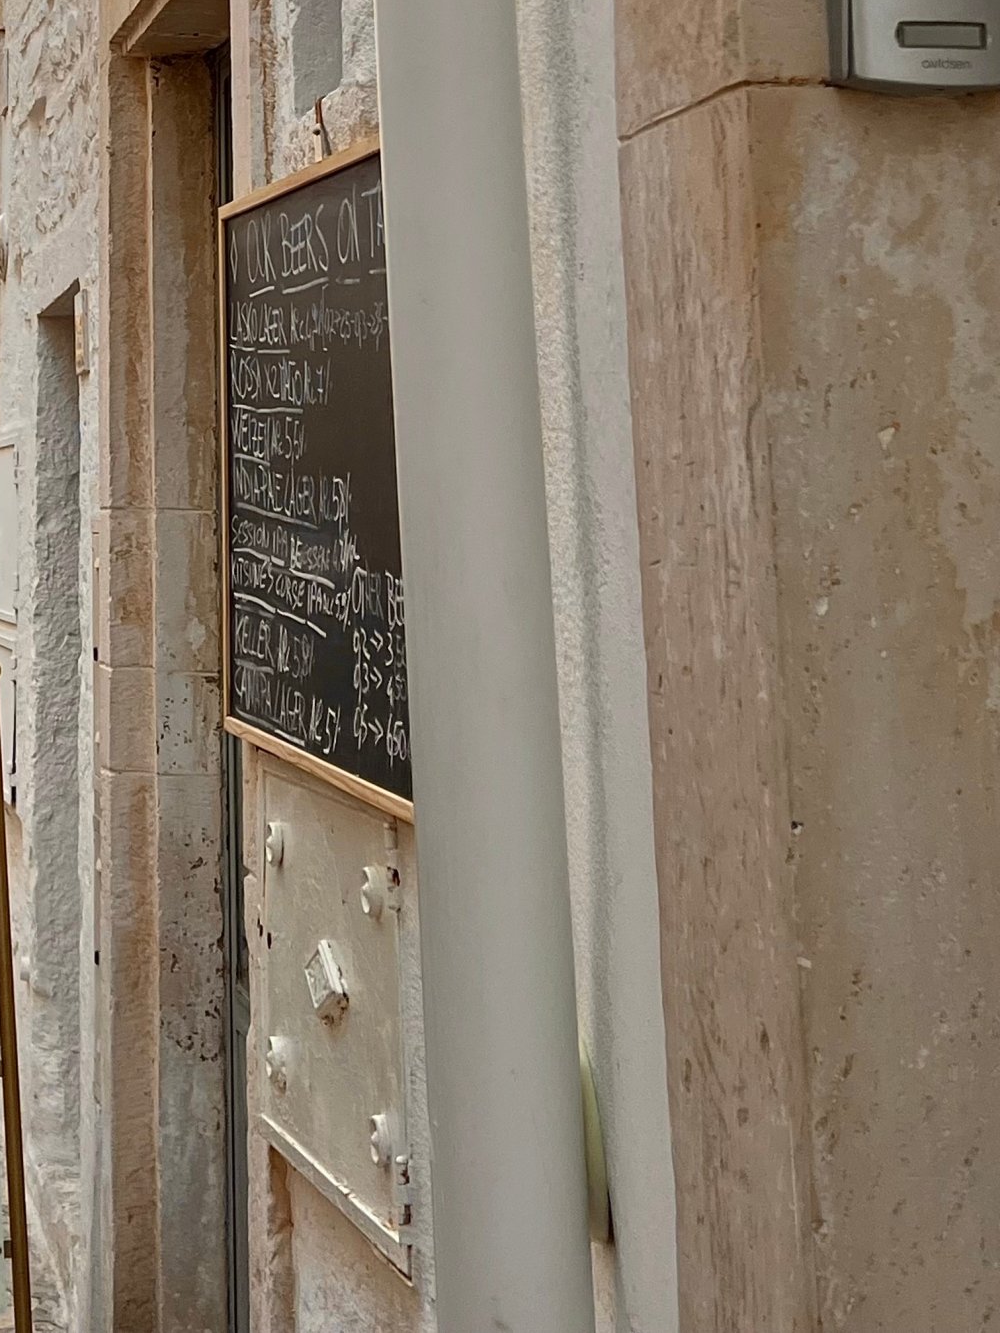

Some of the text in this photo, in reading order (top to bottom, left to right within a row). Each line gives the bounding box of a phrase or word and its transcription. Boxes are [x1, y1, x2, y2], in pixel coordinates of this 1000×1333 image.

[278, 204, 329, 277] BEERS
[337, 183, 360, 264] ON
[361, 180, 385, 258] TA
[234, 612, 276, 668] KELLER
